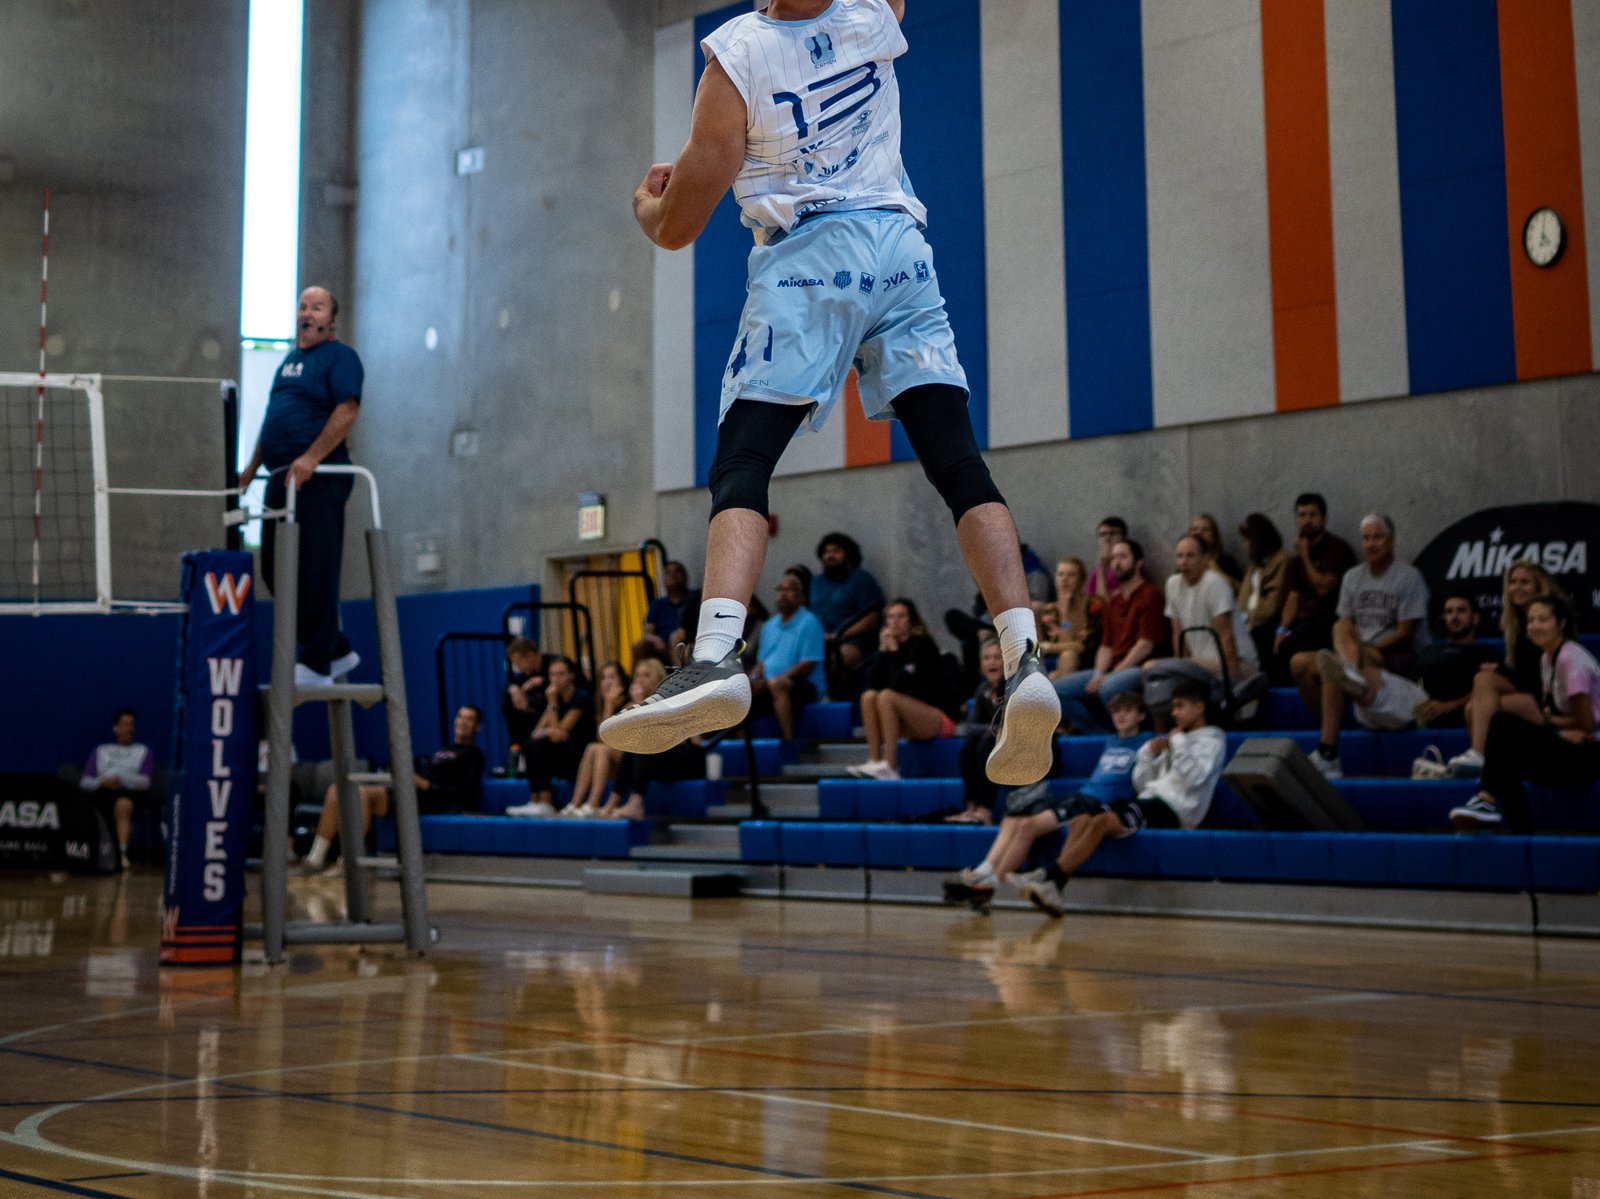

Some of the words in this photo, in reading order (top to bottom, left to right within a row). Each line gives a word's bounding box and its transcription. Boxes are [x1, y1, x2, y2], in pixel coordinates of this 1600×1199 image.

[772, 61, 881, 140] 13
[777, 276, 825, 288] MIKASA
[1446, 527, 1587, 580] MIKASA
[204, 571, 251, 615] W
[203, 658, 243, 901] WOLVES
